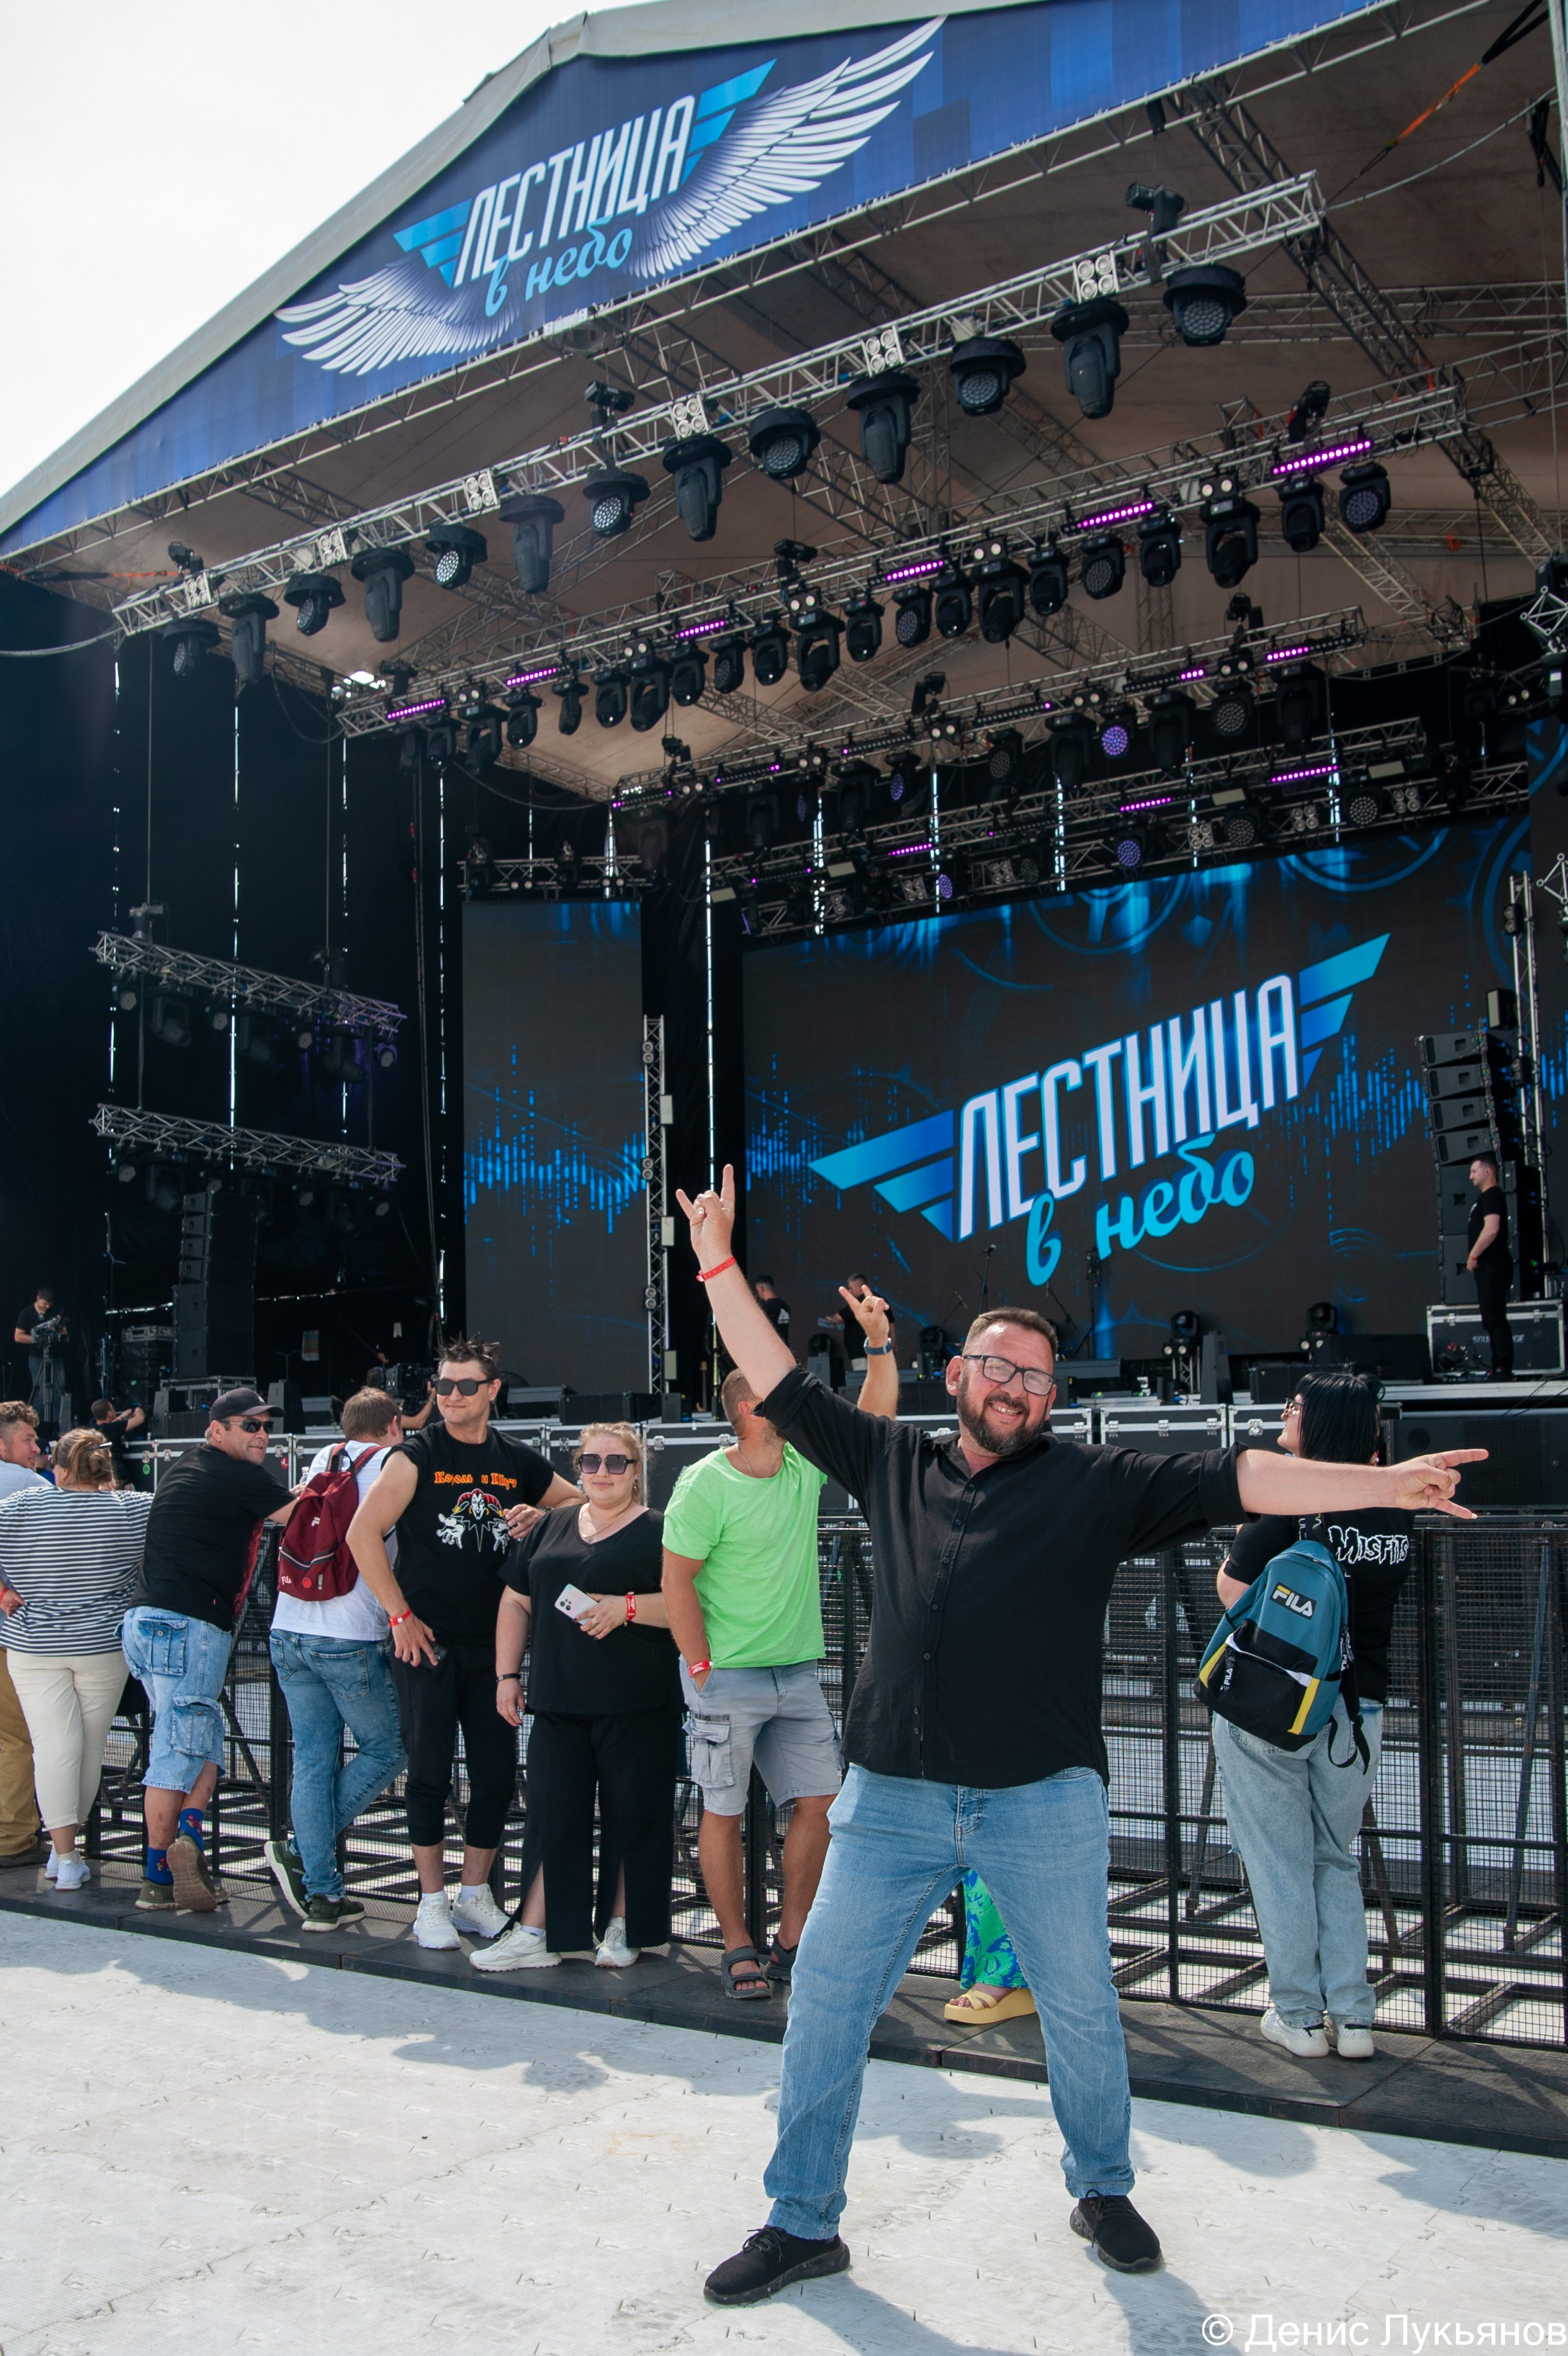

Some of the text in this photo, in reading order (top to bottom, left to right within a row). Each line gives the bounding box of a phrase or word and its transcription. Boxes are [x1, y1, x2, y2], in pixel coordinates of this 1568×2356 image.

[453, 94, 695, 289] ЛЕСТНИЦА
[485, 217, 633, 318] в небо
[959, 974, 1299, 1242] ЛЕСТНИЦА
[1027, 1133, 1255, 1286] в небо
[1272, 1585, 1313, 1617] FILA
[1223, 1668, 1233, 1686] FILA
